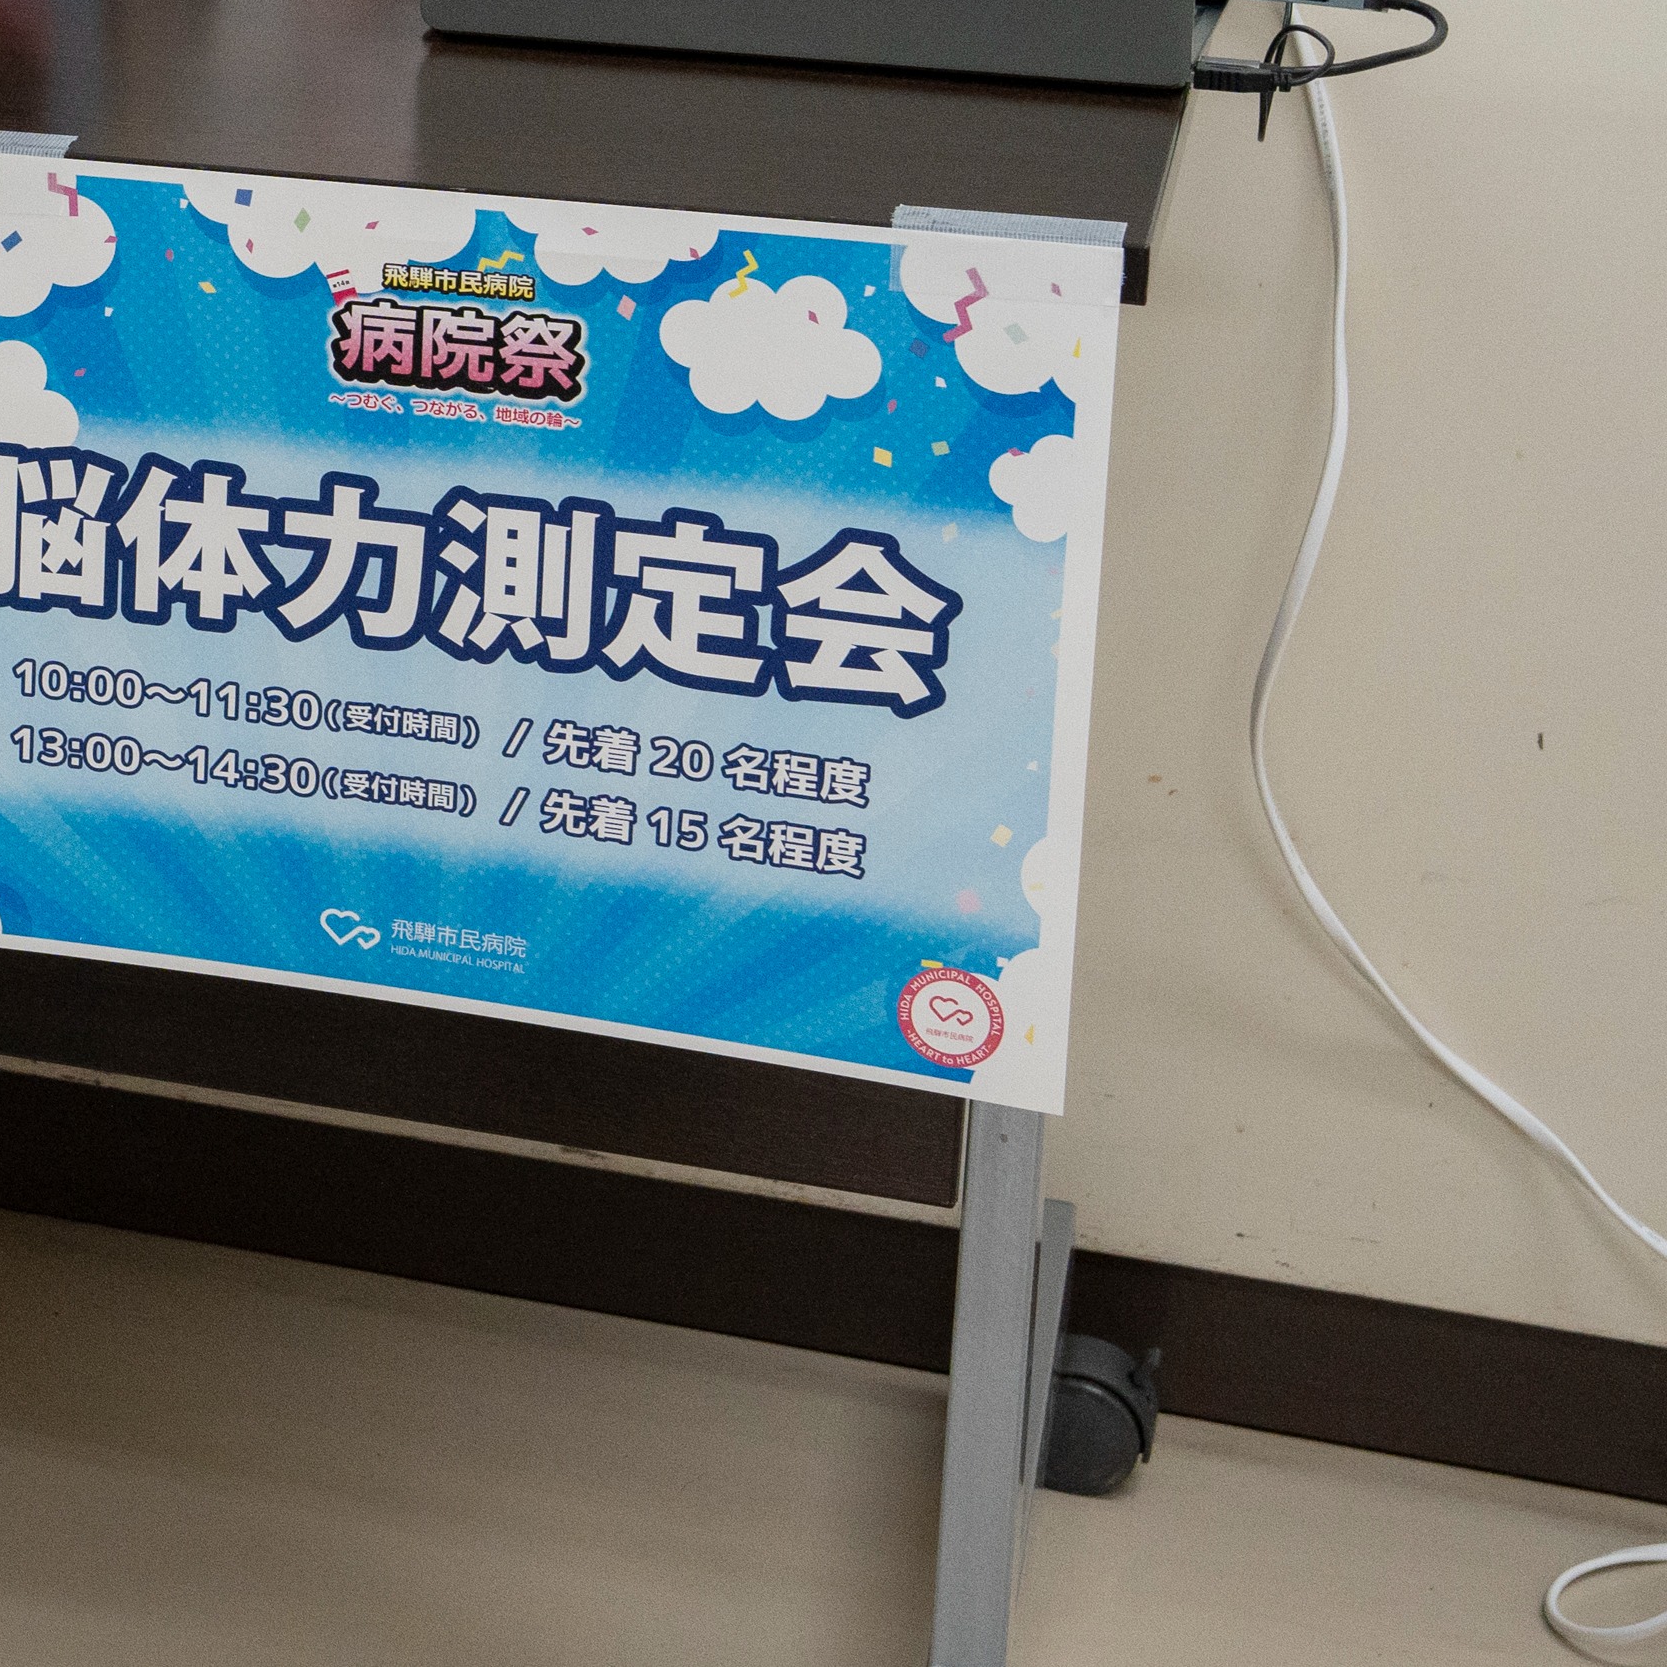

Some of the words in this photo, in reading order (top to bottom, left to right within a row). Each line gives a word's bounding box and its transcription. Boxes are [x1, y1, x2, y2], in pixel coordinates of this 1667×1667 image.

[384, 264, 534, 299] 飛騨市民病院
[339, 303, 577, 390] 病院祭
[545, 721, 639, 777] 先着
[649, 736, 713, 782] 20
[723, 746, 870, 807] 名程度
[542, 790, 634, 846] 先着
[649, 805, 708, 852] 15
[720, 816, 866, 879] 名程度
[391, 919, 526, 958] 飛騨市民病院
[391, 945, 415, 956] HIDA
[418, 949, 474, 966] MUNICIPAL
[476, 957, 525, 974] HOSPITAL
[900, 994, 912, 1020] HIDA
[910, 970, 970, 991] MUNICIPAL
[975, 983, 1001, 1036] HOSPITAL
[942, 1056, 953, 1065] to
